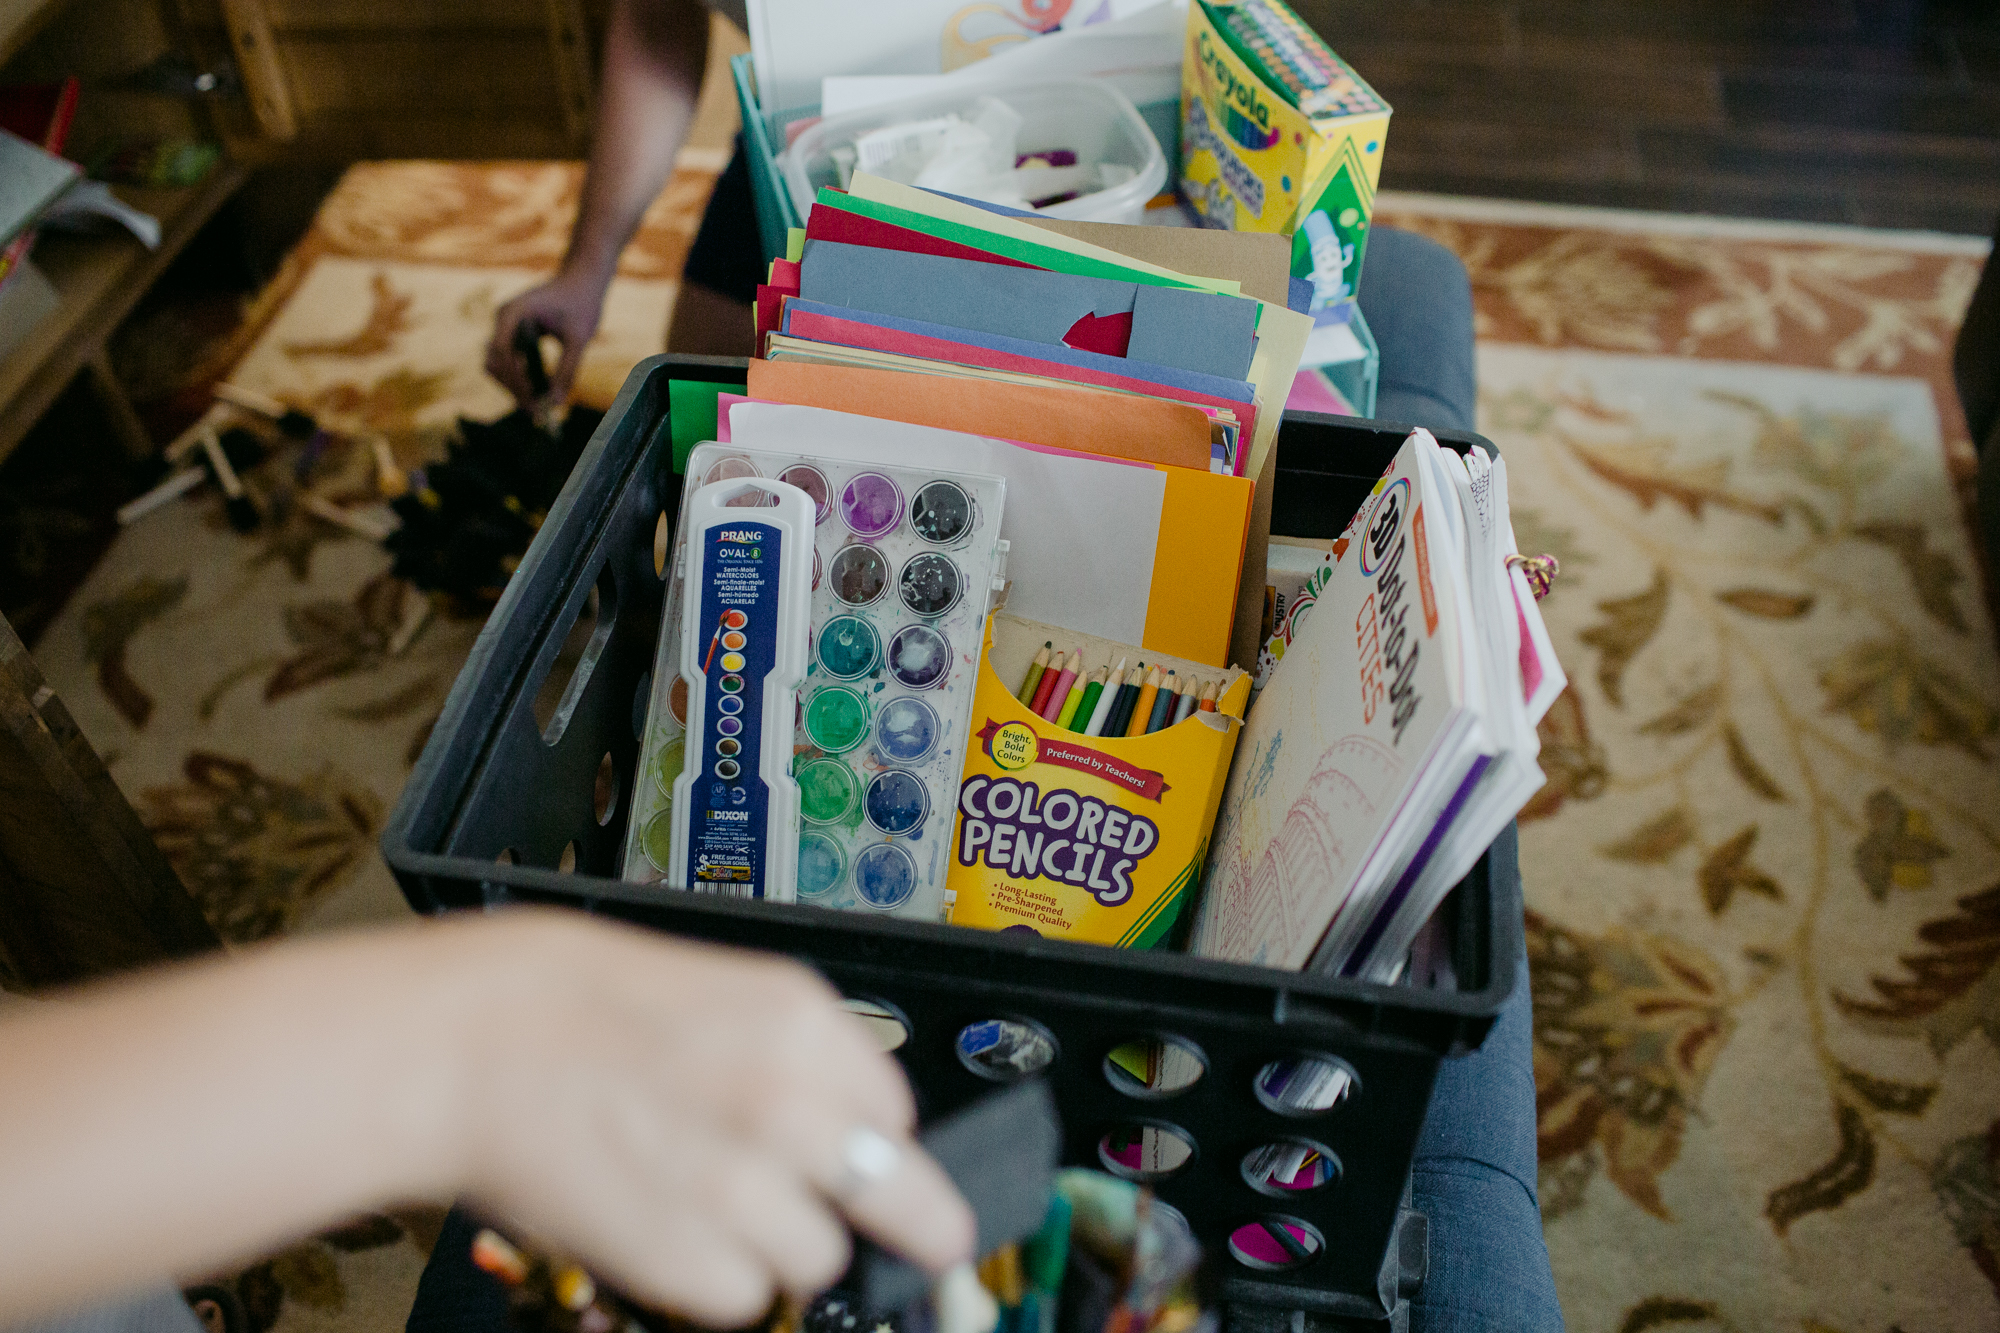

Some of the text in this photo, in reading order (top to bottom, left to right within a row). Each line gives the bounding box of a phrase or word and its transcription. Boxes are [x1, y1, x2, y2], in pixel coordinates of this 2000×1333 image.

[720, 531, 762, 541] PRANG
[1369, 493, 1400, 560] 3D
[1356, 592, 1385, 725] CITIES
[1002, 729, 1031, 745] Bright,
[1004, 741, 1025, 753] Bold
[997, 749, 1025, 764] Colors
[1046, 748, 1146, 788] Preferred by Teachers!
[714, 811, 749, 821] DIXON
[961, 779, 1154, 855] COLORED
[963, 819, 1133, 902] PENCILS
[997, 892, 1064, 917] Pre-Sharpened
[1000, 882, 1057, 906] Long-Lasting
[994, 902, 1072, 930] Premium Quality
